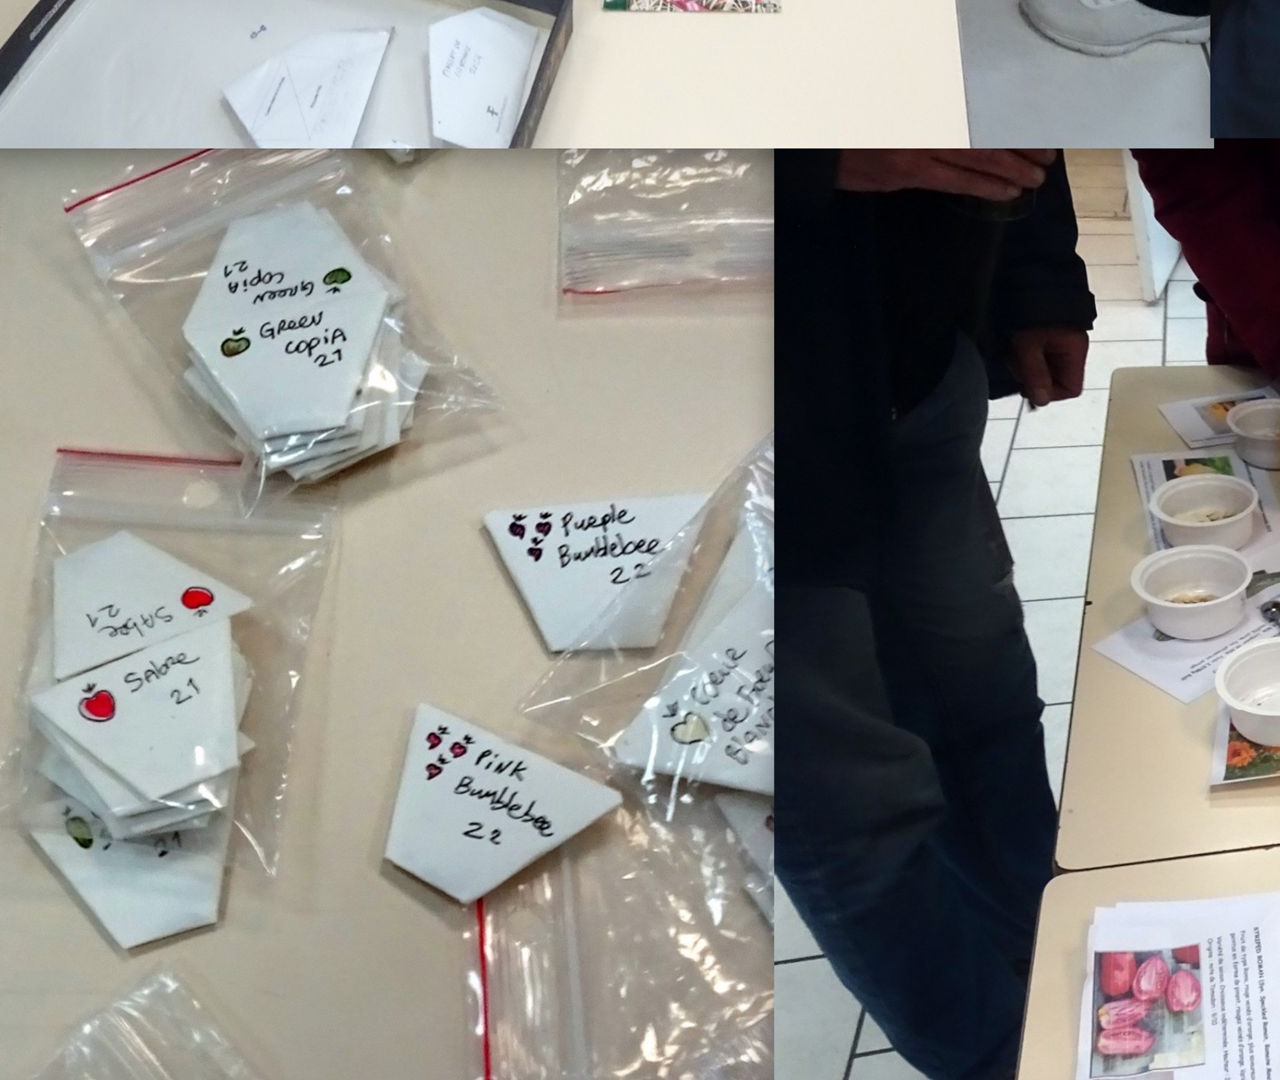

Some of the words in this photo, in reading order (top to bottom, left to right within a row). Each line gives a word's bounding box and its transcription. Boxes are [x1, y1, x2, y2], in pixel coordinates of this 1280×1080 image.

[314, 349, 343, 367] 21
[610, 563, 652, 585] 22
[170, 678, 201, 705] 21
[462, 822, 502, 845] 22
